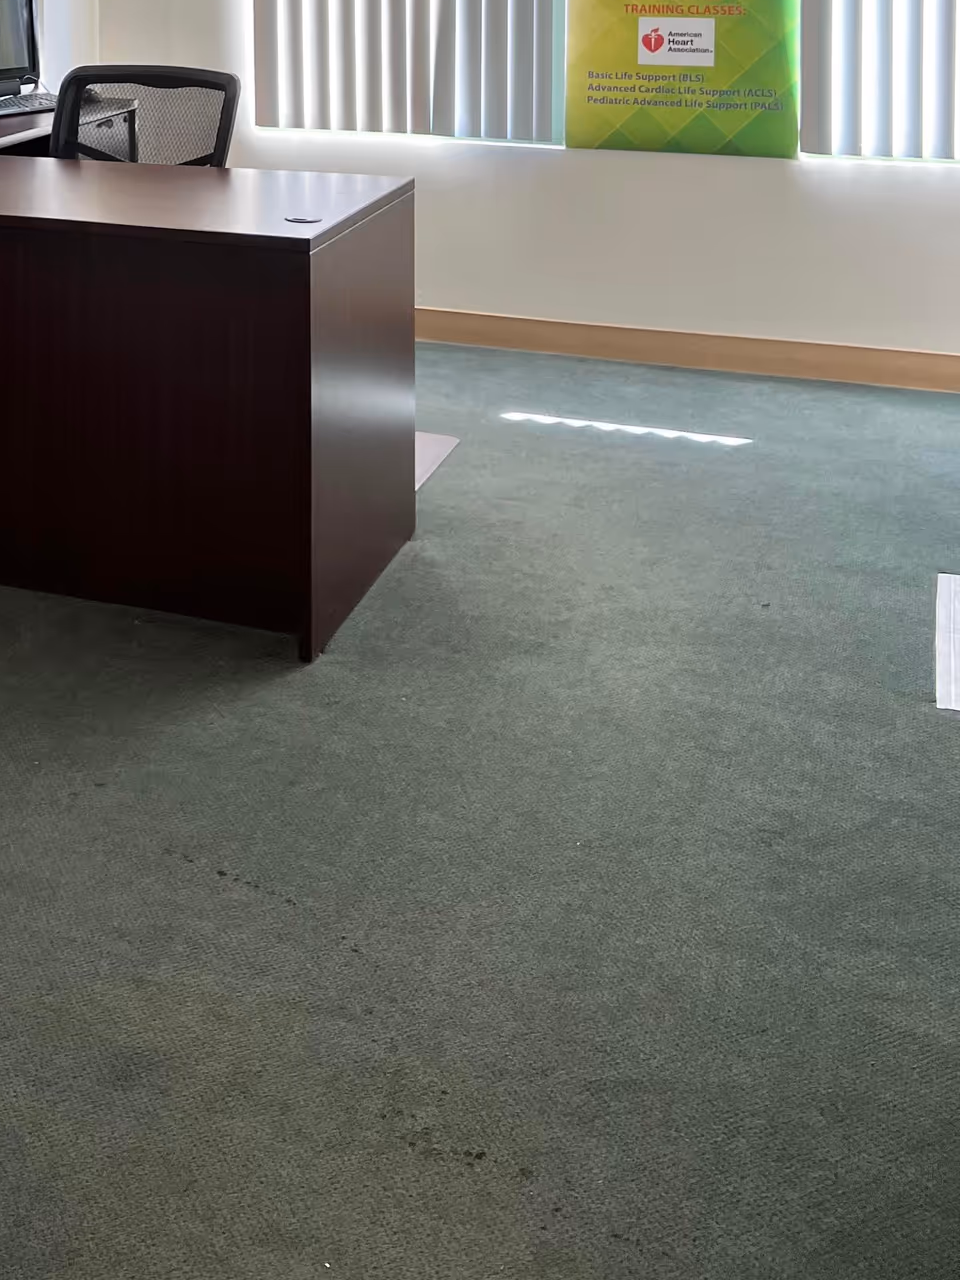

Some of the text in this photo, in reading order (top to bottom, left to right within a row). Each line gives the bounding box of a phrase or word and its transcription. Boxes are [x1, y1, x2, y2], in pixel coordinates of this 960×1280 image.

[624, 4, 746, 16] TRAINING CLASSES:
[668, 38, 694, 46] Heart
[588, 71, 704, 83] Basic Life Support (BLS)
